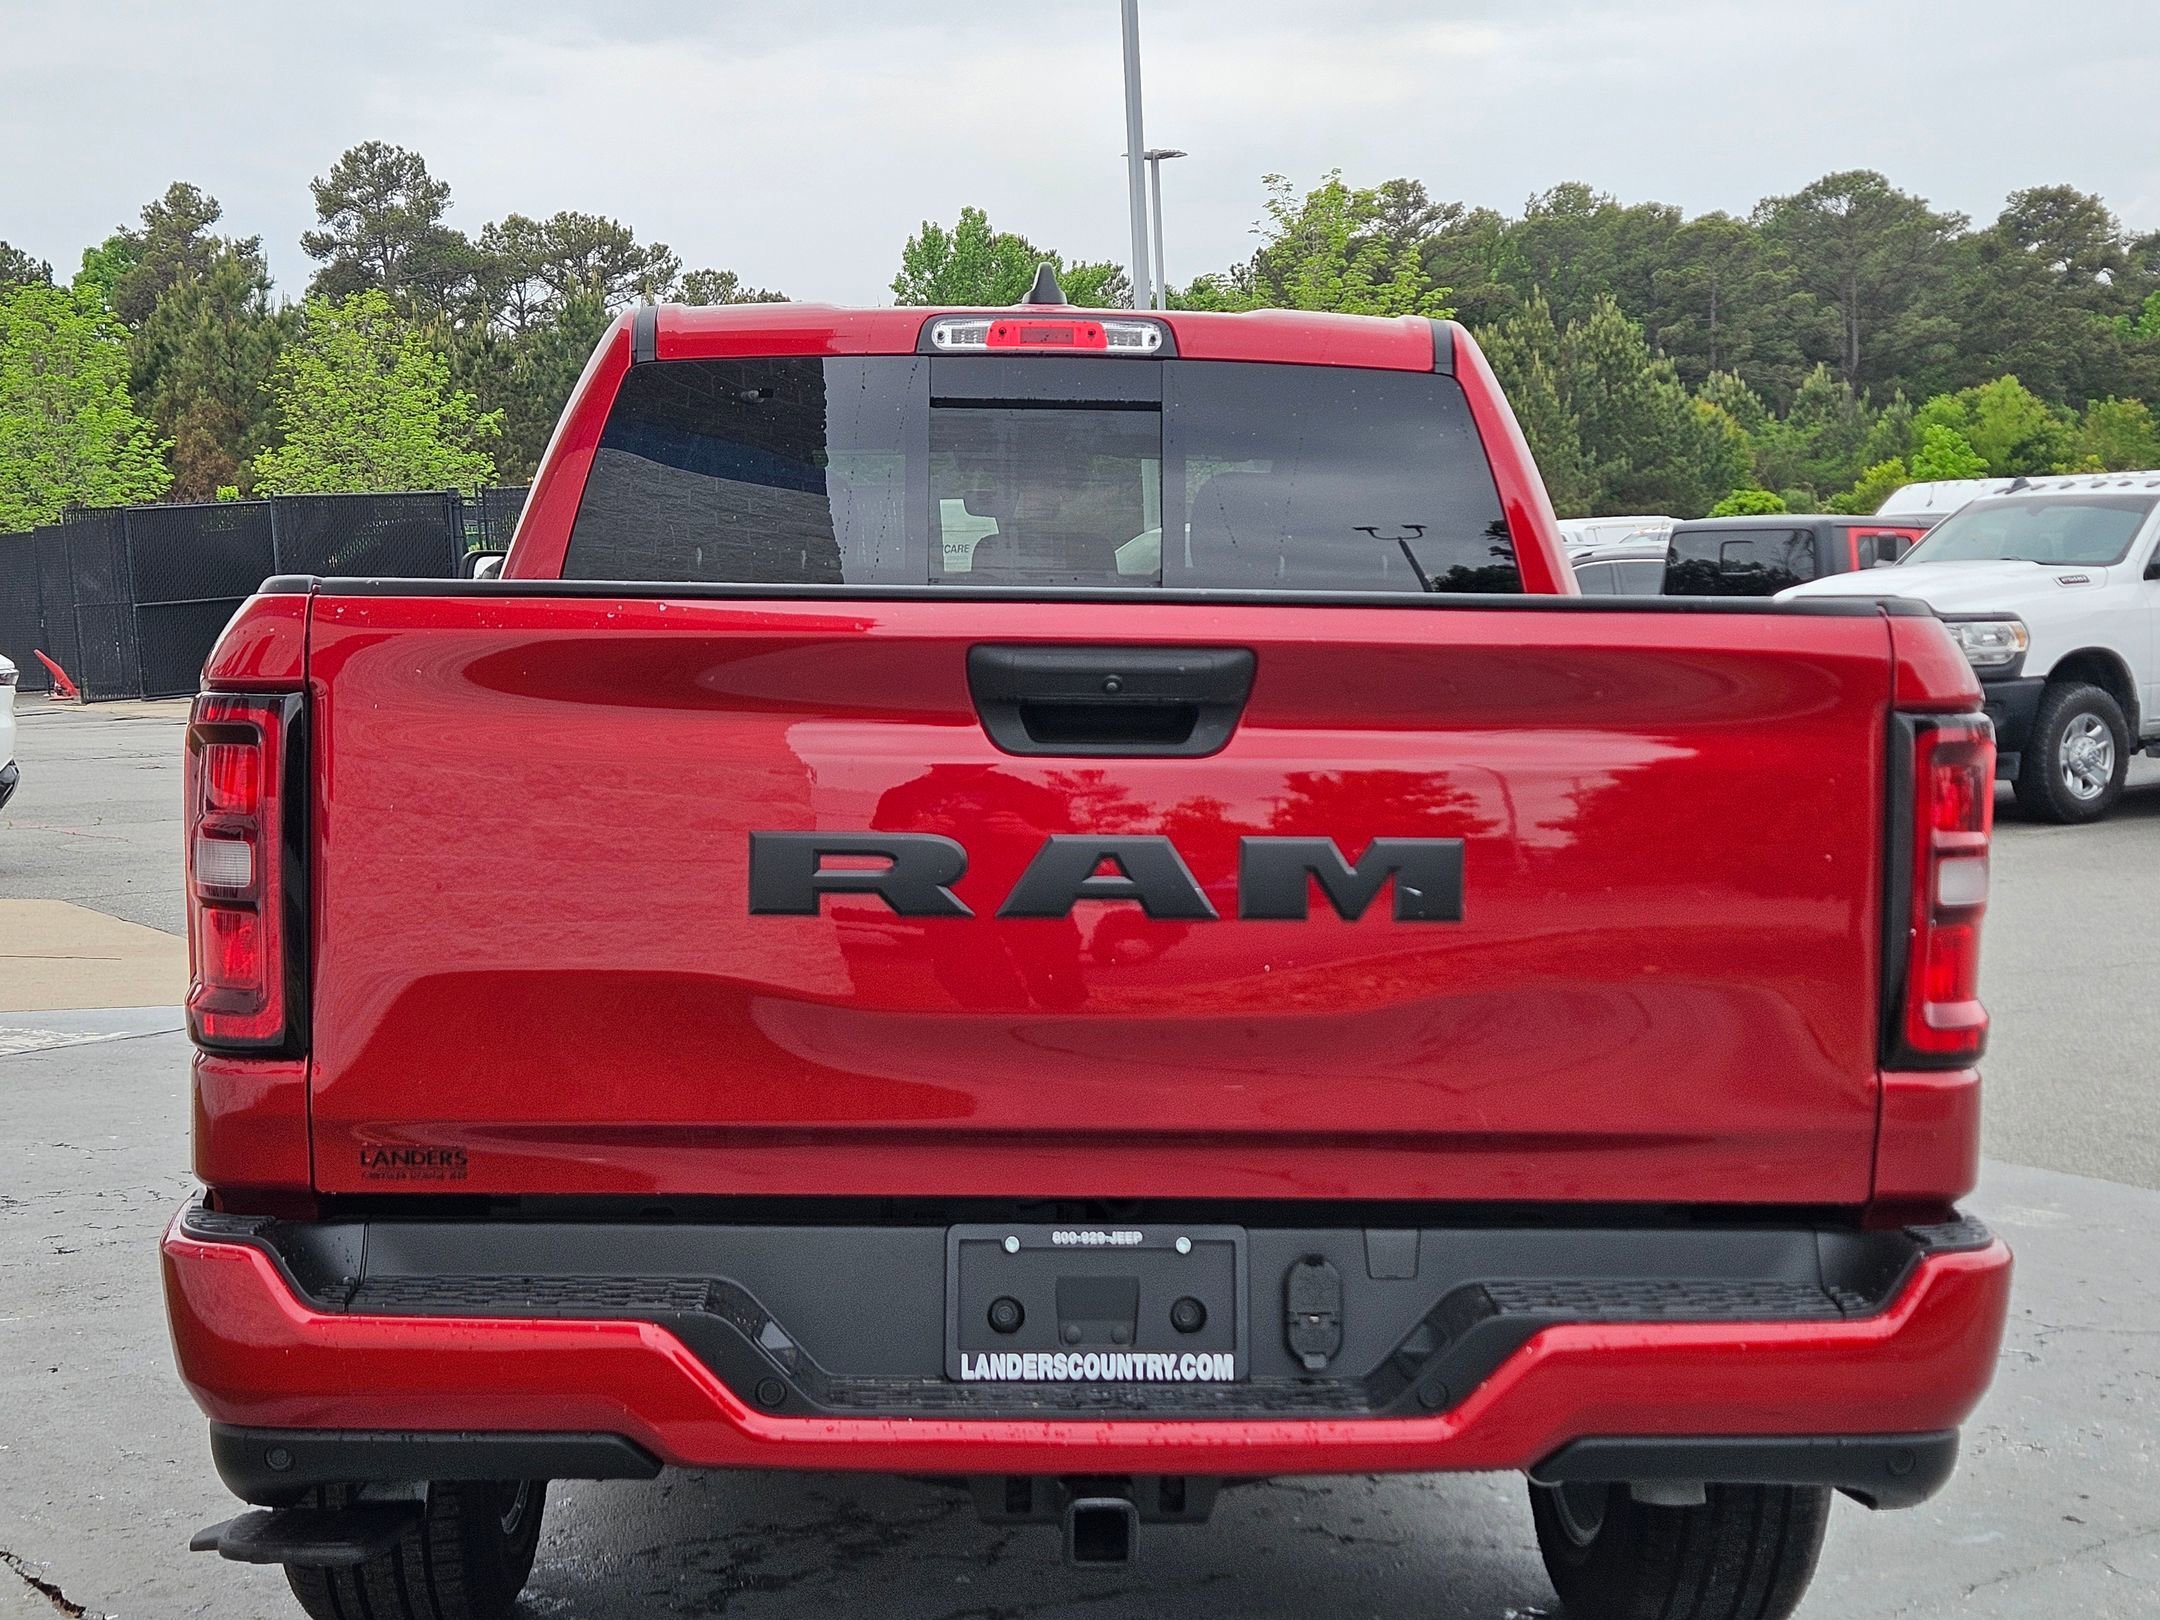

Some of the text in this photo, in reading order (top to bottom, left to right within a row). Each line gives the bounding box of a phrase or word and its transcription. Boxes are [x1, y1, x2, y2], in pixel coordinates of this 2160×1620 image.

[944, 544, 970, 554] CARE
[749, 831, 1465, 922] RAM
[360, 1150, 468, 1168] LANDERS
[961, 1353, 1235, 1381] LANDERSCOUNTRY.COM
